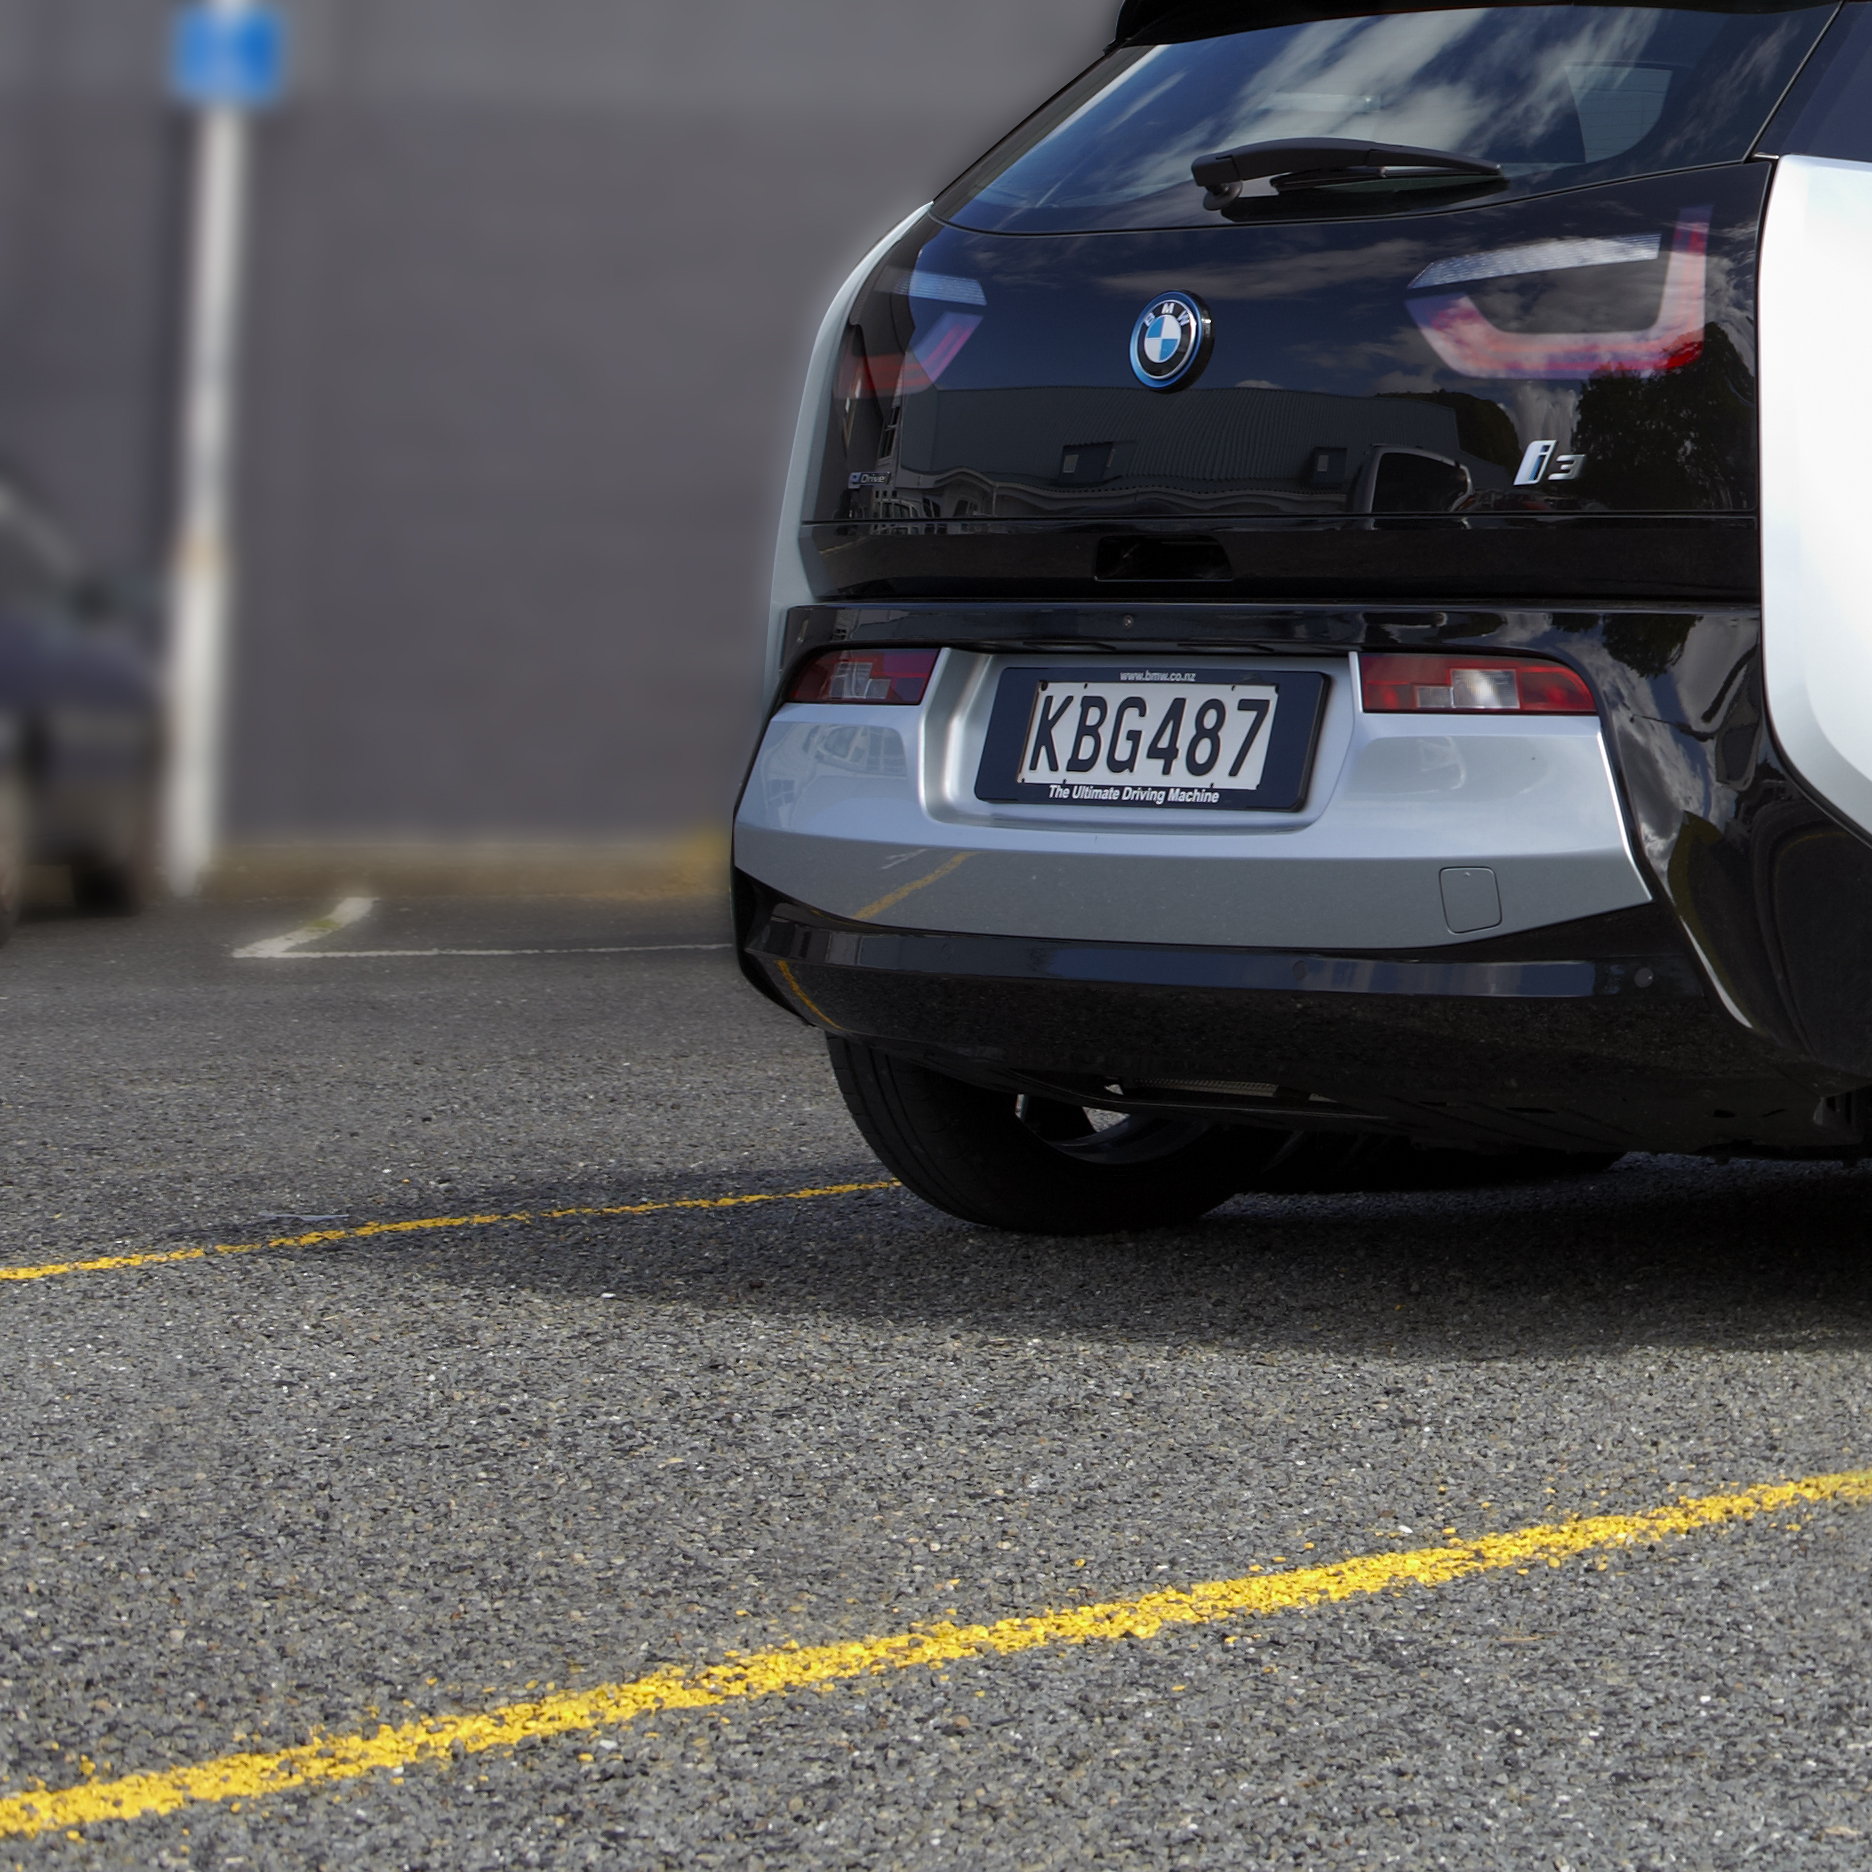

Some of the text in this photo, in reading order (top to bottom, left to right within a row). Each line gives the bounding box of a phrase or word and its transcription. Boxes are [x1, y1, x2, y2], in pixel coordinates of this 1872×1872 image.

[1143, 302, 1190, 327] BMW
[1513, 440, 1585, 485] i3
[1120, 670, 1196, 682] www.bmw.co.nz
[1029, 695, 1271, 777] KBG487
[1049, 784, 1219, 804] The Ultimate Driving Machine
